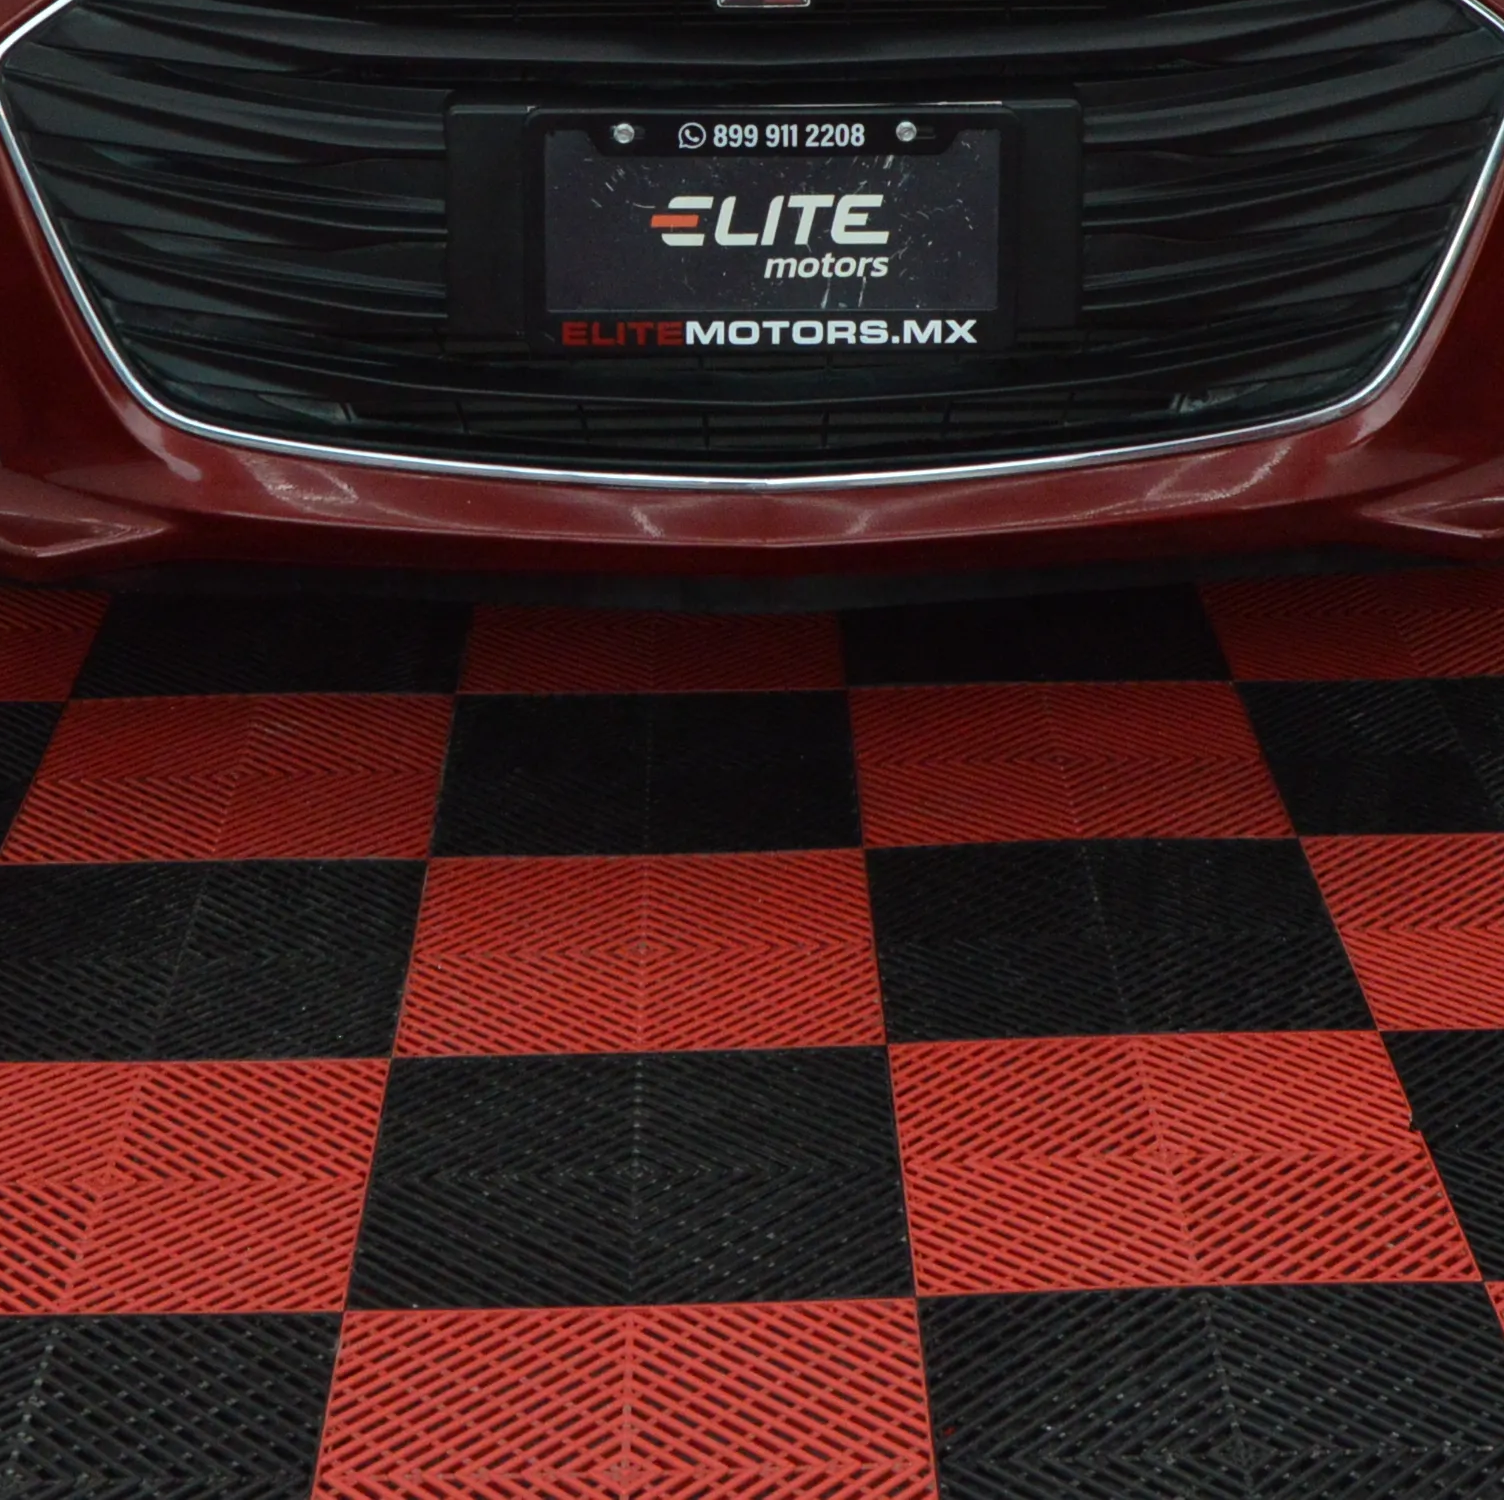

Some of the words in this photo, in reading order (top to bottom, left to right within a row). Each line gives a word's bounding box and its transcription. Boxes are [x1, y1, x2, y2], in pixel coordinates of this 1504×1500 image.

[713, 123, 758, 148] 899
[766, 123, 798, 148] 911
[805, 123, 865, 148] 2208
[650, 194, 890, 247] ELITE
[763, 252, 889, 279] motors
[561, 318, 978, 346] ELITEMOTORS.MX
